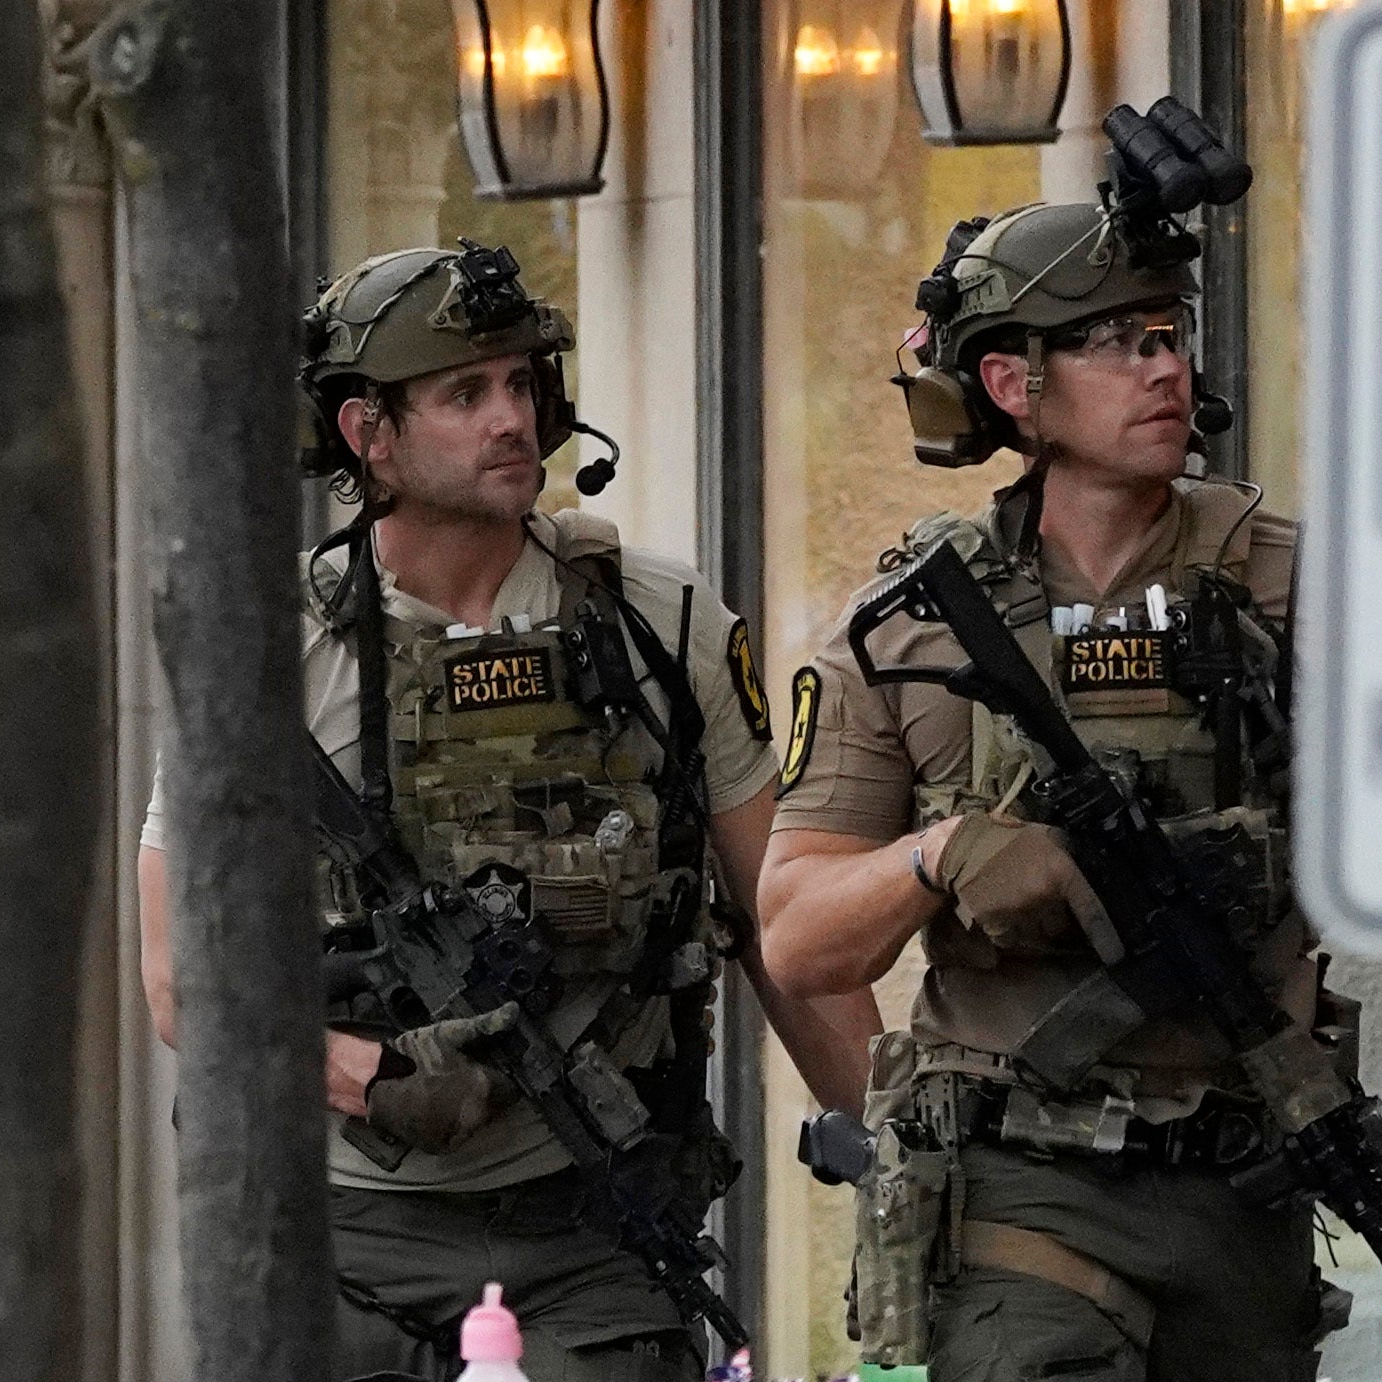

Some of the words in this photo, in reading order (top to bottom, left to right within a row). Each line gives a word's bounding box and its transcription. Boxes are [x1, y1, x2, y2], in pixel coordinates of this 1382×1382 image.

[1071, 637, 1163, 662] STATE
[452, 655, 542, 685] STATE
[1070, 660, 1164, 682] POLICE
[453, 676, 546, 705] POLICE
